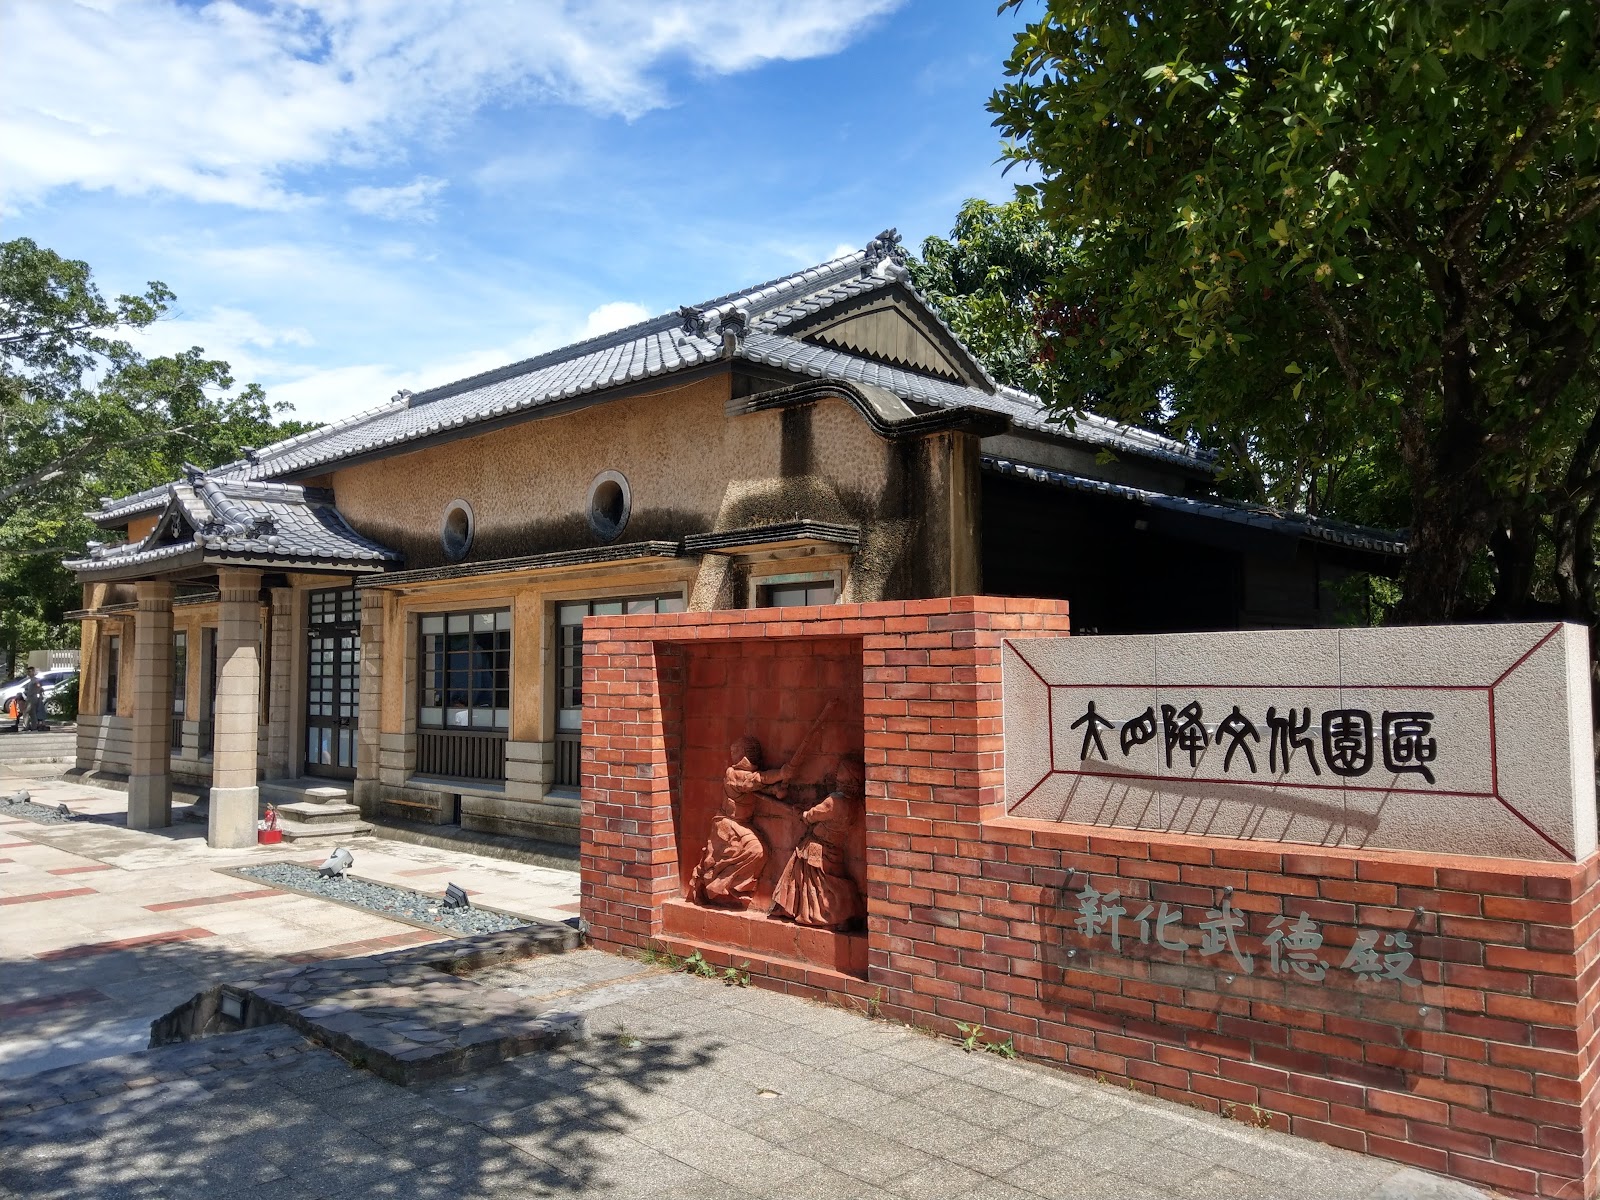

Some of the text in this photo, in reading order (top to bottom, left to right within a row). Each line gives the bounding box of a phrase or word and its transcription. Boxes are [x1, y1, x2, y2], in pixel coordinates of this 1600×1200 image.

[1073, 884, 1422, 987] 新化武德殿
